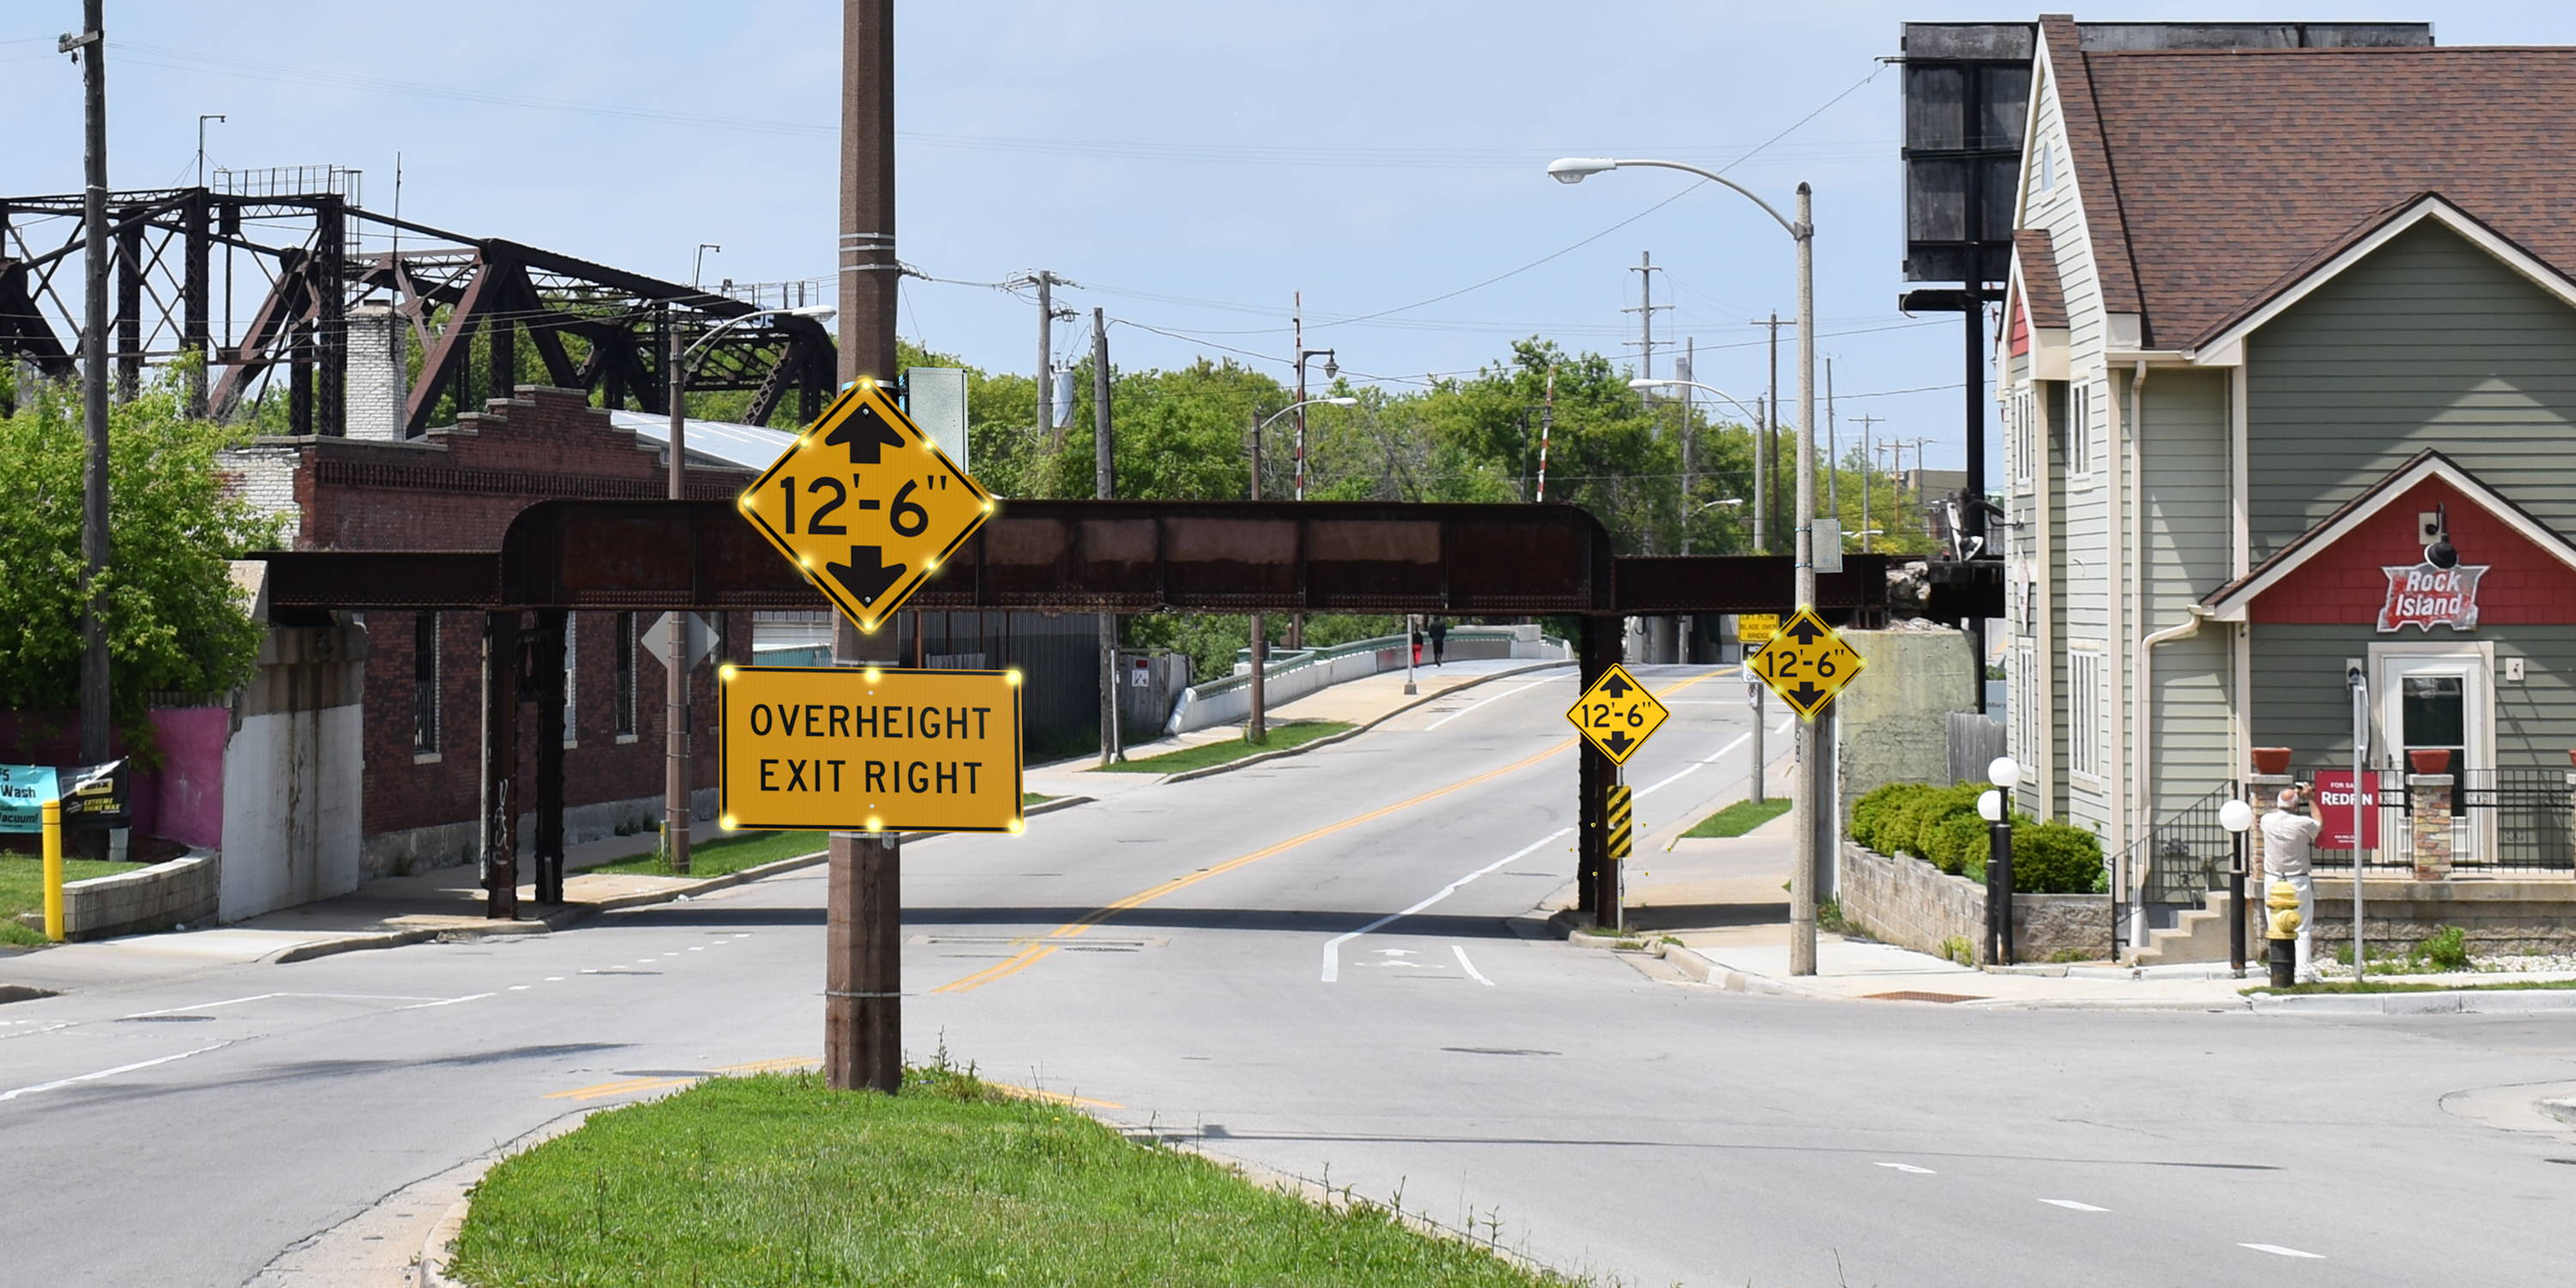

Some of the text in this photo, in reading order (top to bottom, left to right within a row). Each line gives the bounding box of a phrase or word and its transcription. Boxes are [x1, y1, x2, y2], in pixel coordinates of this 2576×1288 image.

[780, 472, 947, 538] 12'-6"
[2405, 569, 2462, 592] Rock
[2394, 593, 2463, 617] Island
[1765, 648, 1845, 678] 12'-6"
[750, 703, 991, 740] OVERHEIGHT
[1582, 702, 1651, 728] 12'-6"
[760, 758, 982, 794] EXIT RIGHT
[0, 784, 36, 799] Wash
[2321, 791, 2373, 805] REDFN
